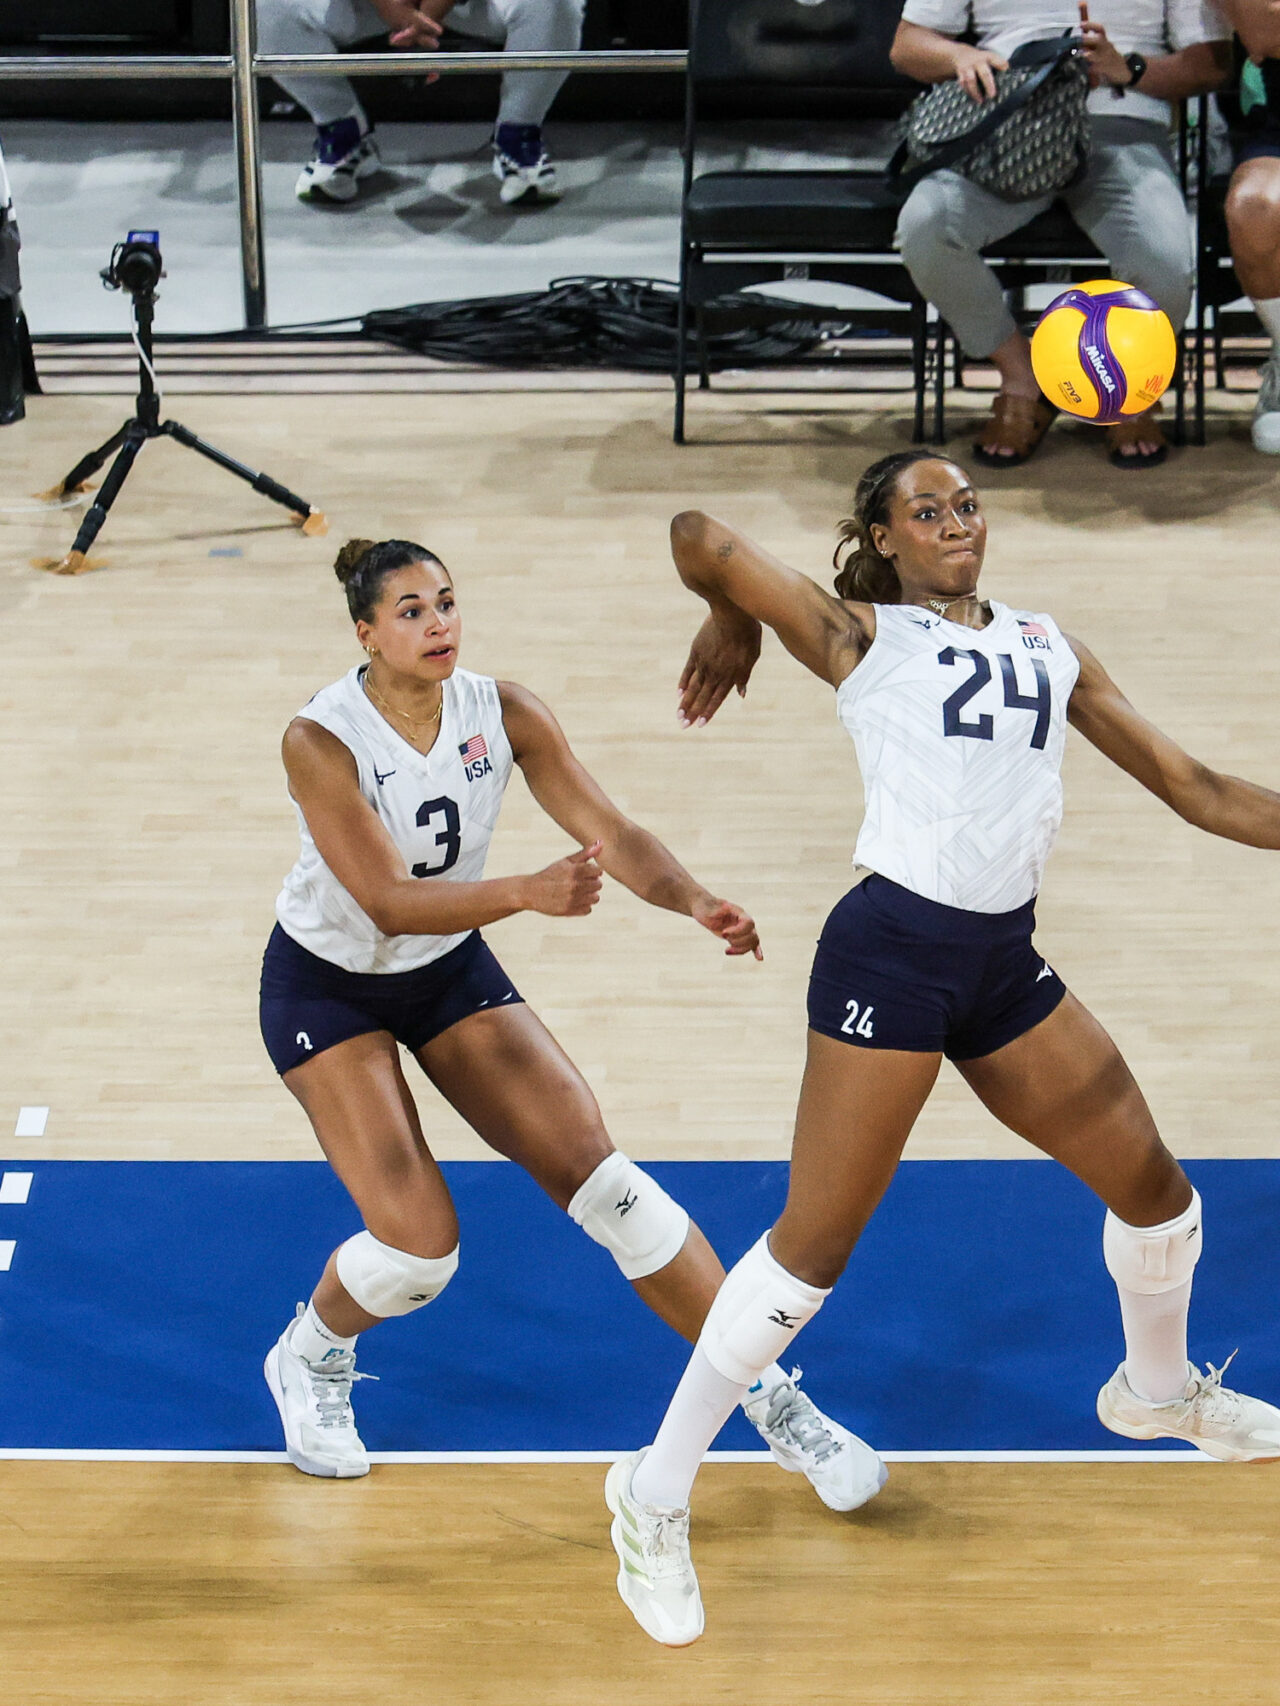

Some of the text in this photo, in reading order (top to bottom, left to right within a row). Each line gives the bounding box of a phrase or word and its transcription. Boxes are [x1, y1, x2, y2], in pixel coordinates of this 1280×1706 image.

[1085, 345, 1117, 394] MIKASA
[1063, 381, 1082, 404] FIVB
[1022, 635, 1053, 653] USA
[937, 646, 1051, 750] 24
[464, 757, 494, 782] USA
[411, 795, 461, 879] 3
[840, 999, 874, 1039] 24
